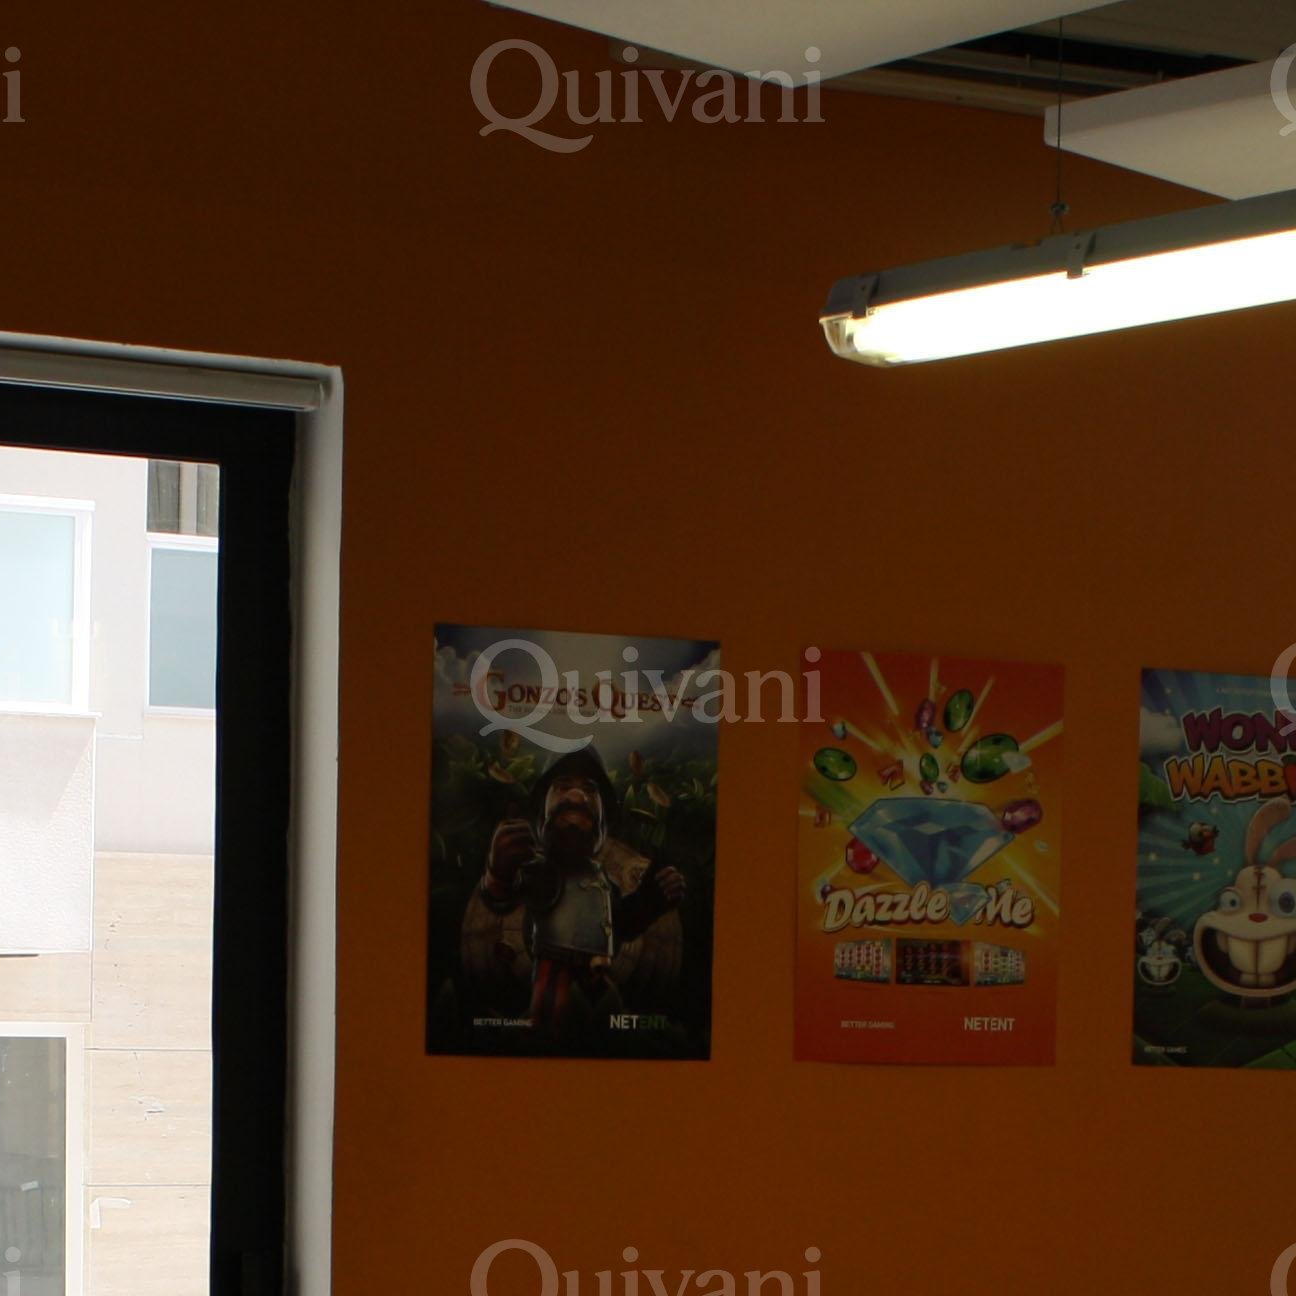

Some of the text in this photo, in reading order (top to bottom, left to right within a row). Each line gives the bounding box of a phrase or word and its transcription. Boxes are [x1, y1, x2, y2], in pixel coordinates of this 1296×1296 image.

[822, 880, 1036, 935] Dazzle Me
[963, 1016, 1016, 1032] NETENT
